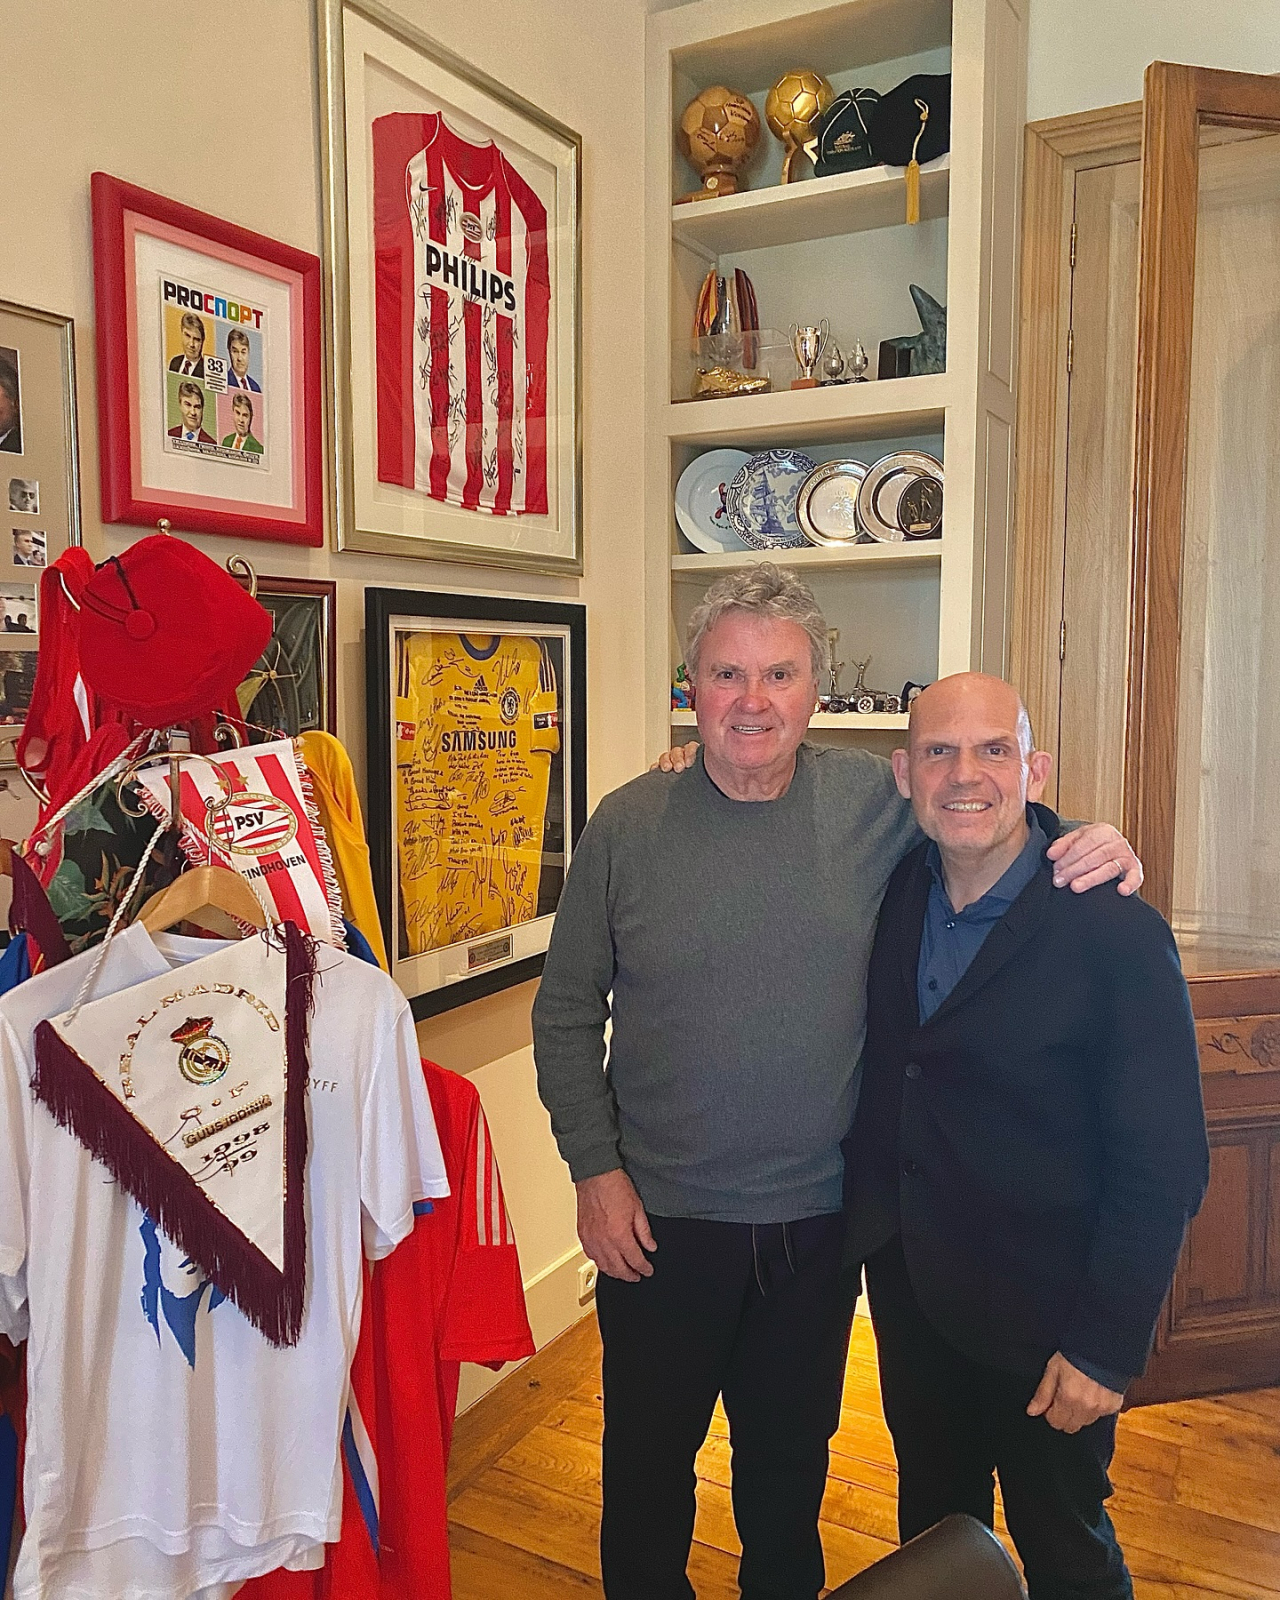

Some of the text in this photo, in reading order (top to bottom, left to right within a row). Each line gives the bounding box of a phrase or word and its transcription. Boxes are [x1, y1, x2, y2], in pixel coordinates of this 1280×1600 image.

[426, 243, 516, 311] PHILIPS
[207, 358, 224, 373] 33
[441, 730, 517, 752] SAMSUNG
[234, 811, 264, 830] PSV
[119, 1008, 159, 1100] REAL
[160, 982, 281, 1032] MADRID
[186, 1120, 223, 1144] GUUS
